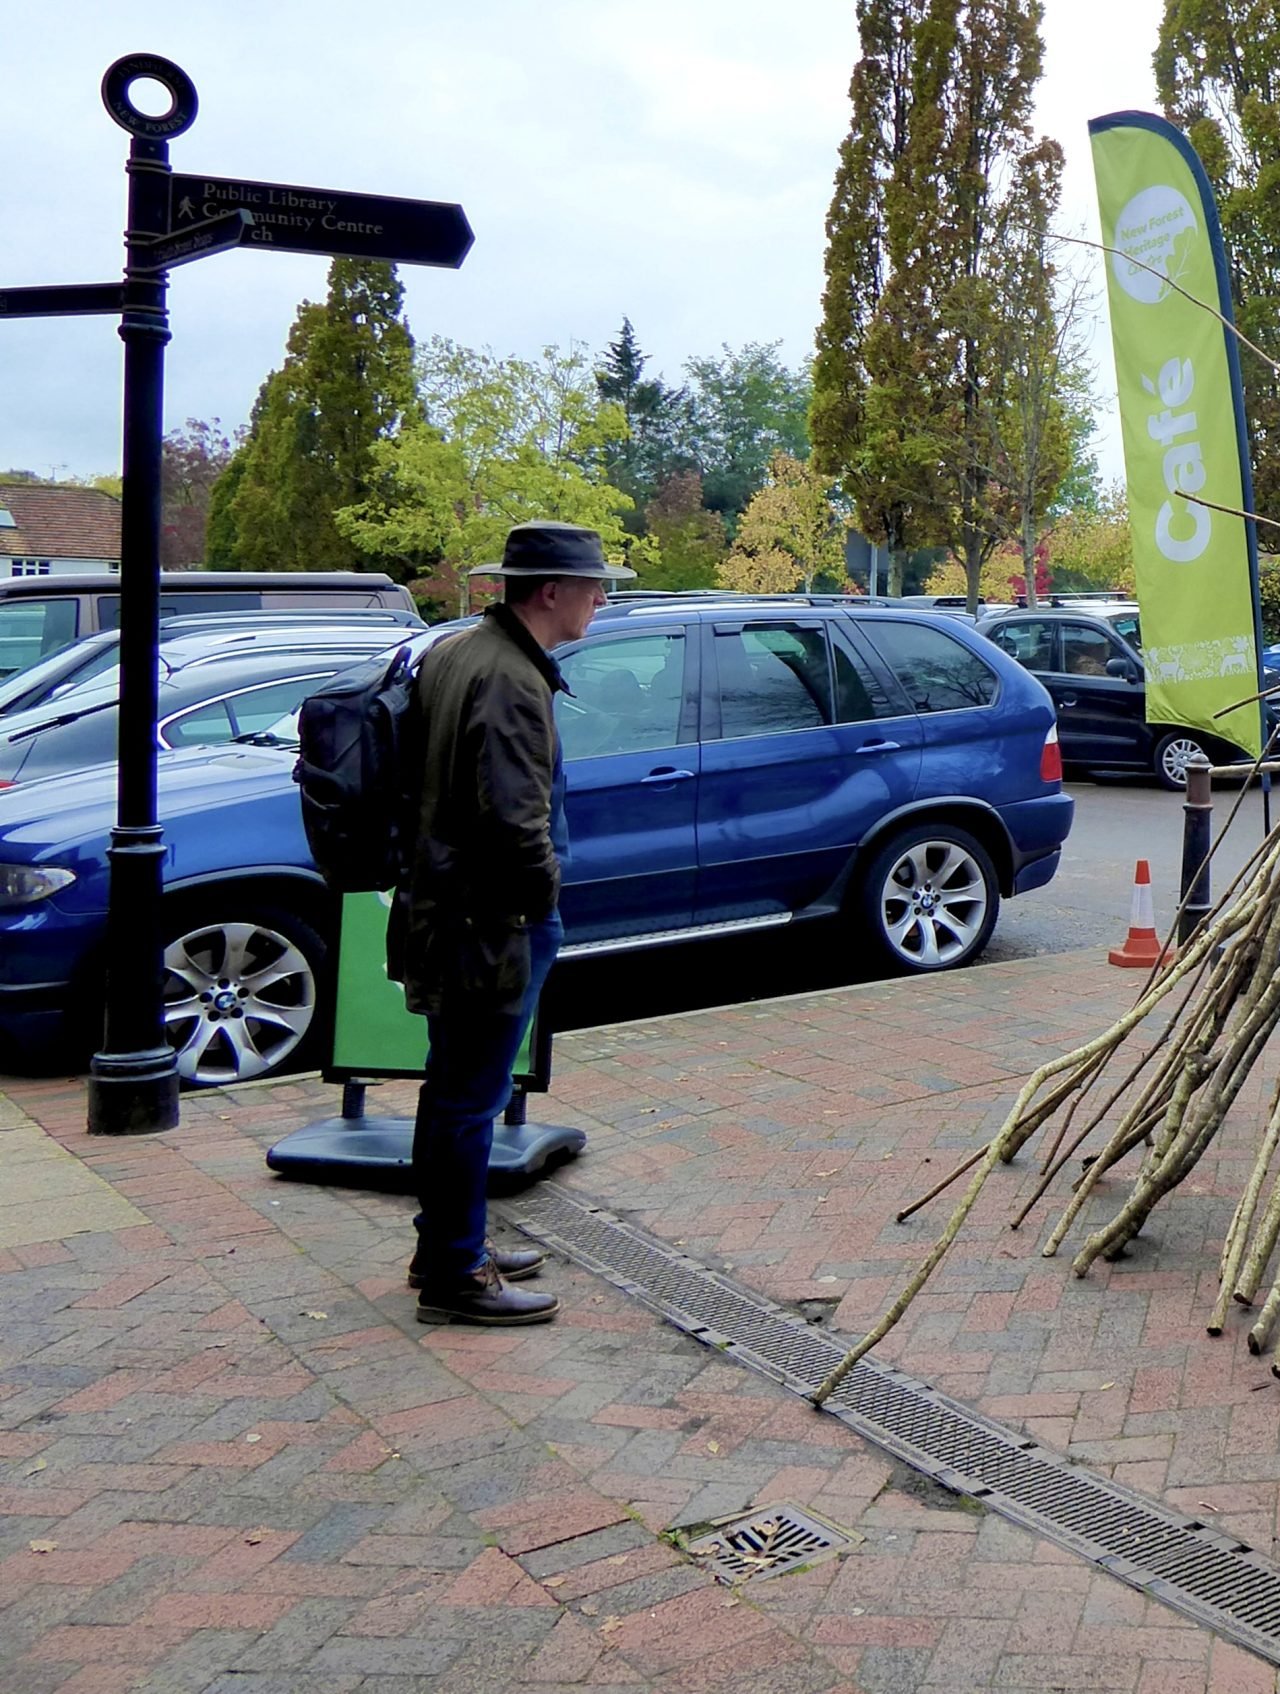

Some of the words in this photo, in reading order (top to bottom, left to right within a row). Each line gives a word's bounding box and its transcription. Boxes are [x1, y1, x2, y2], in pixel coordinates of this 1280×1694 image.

[203, 182, 262, 204] Public
[268, 189, 338, 215] Library
[321, 214, 384, 236] Centre
[1121, 224, 1147, 240] New
[1149, 207, 1184, 230] Forest
[1141, 356, 1211, 563] Café
